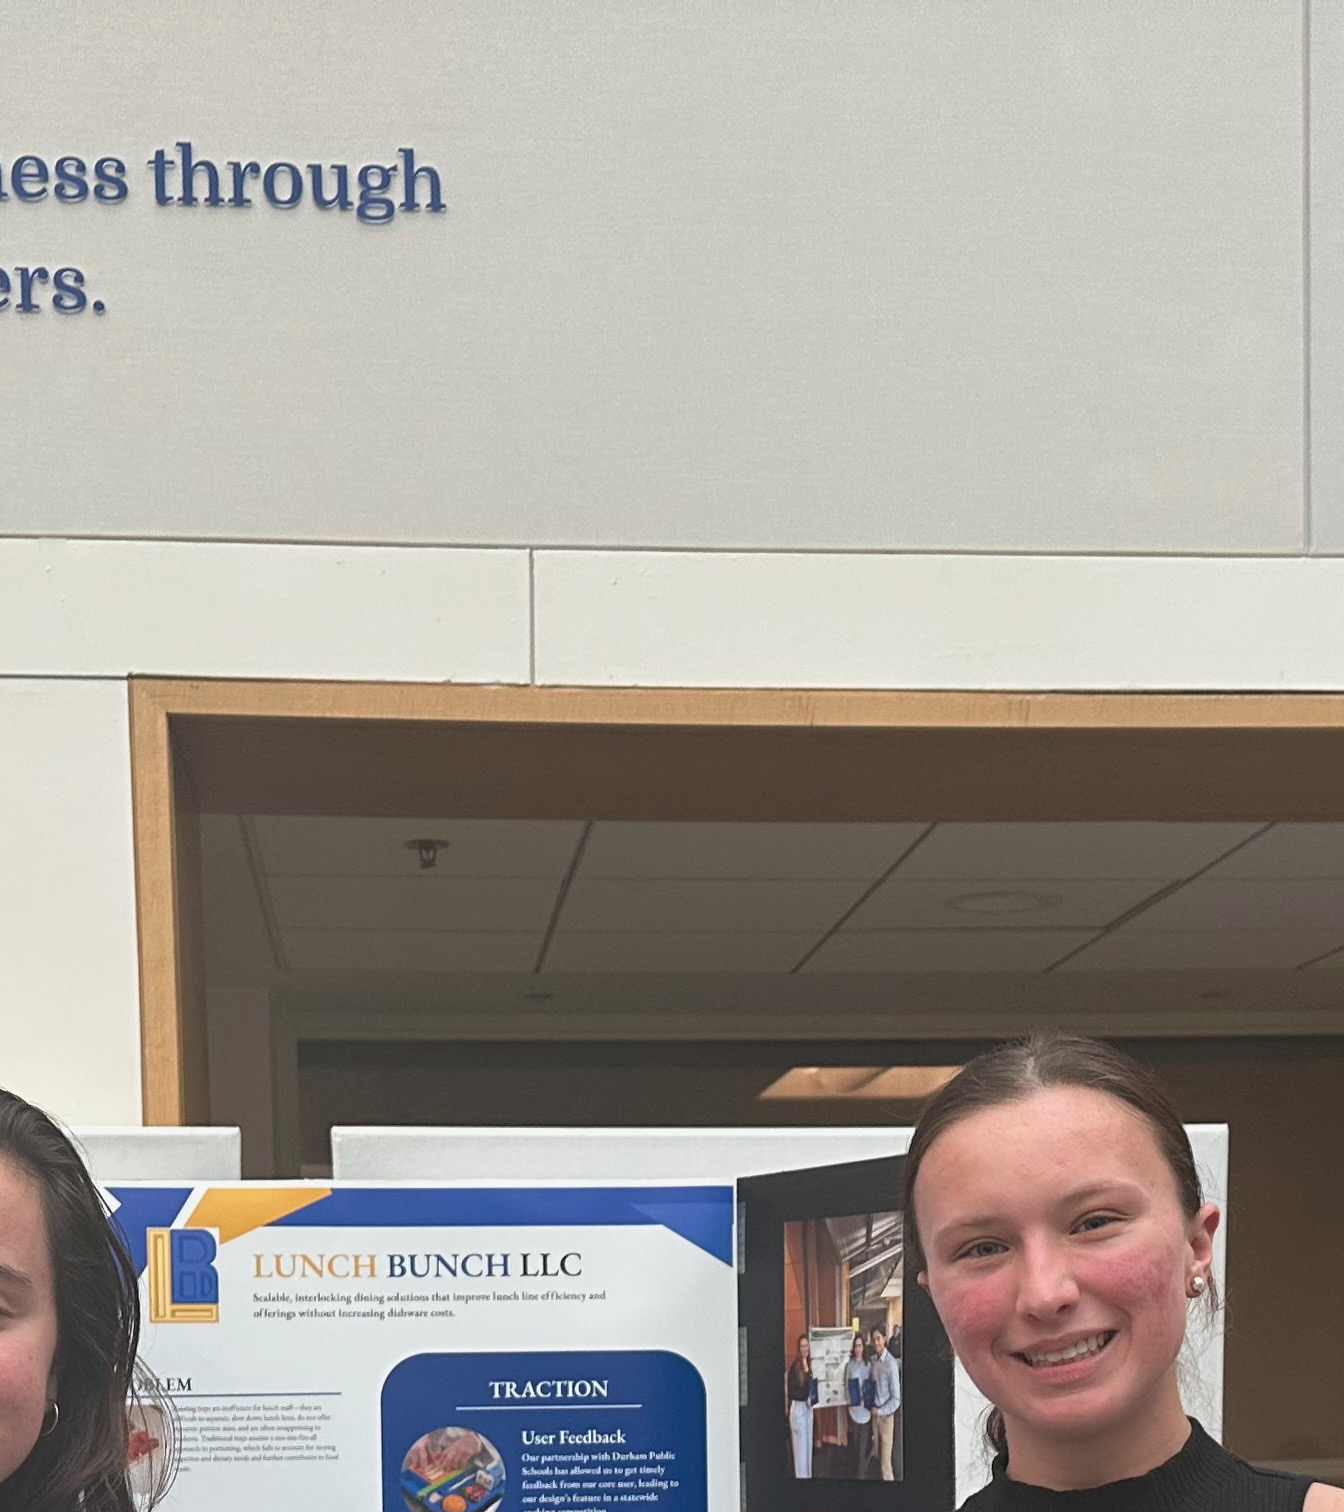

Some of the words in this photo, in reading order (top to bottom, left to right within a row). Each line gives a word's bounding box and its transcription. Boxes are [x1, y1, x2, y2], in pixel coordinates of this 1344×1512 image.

[147, 141, 446, 223] through
[253, 1254, 377, 1278] LUNCH
[387, 1252, 511, 1278] BUNCH
[520, 1252, 583, 1277] LLC
[489, 1380, 609, 1399] TRACTION
[521, 1430, 556, 1445] User
[559, 1430, 626, 1444] Feedback
